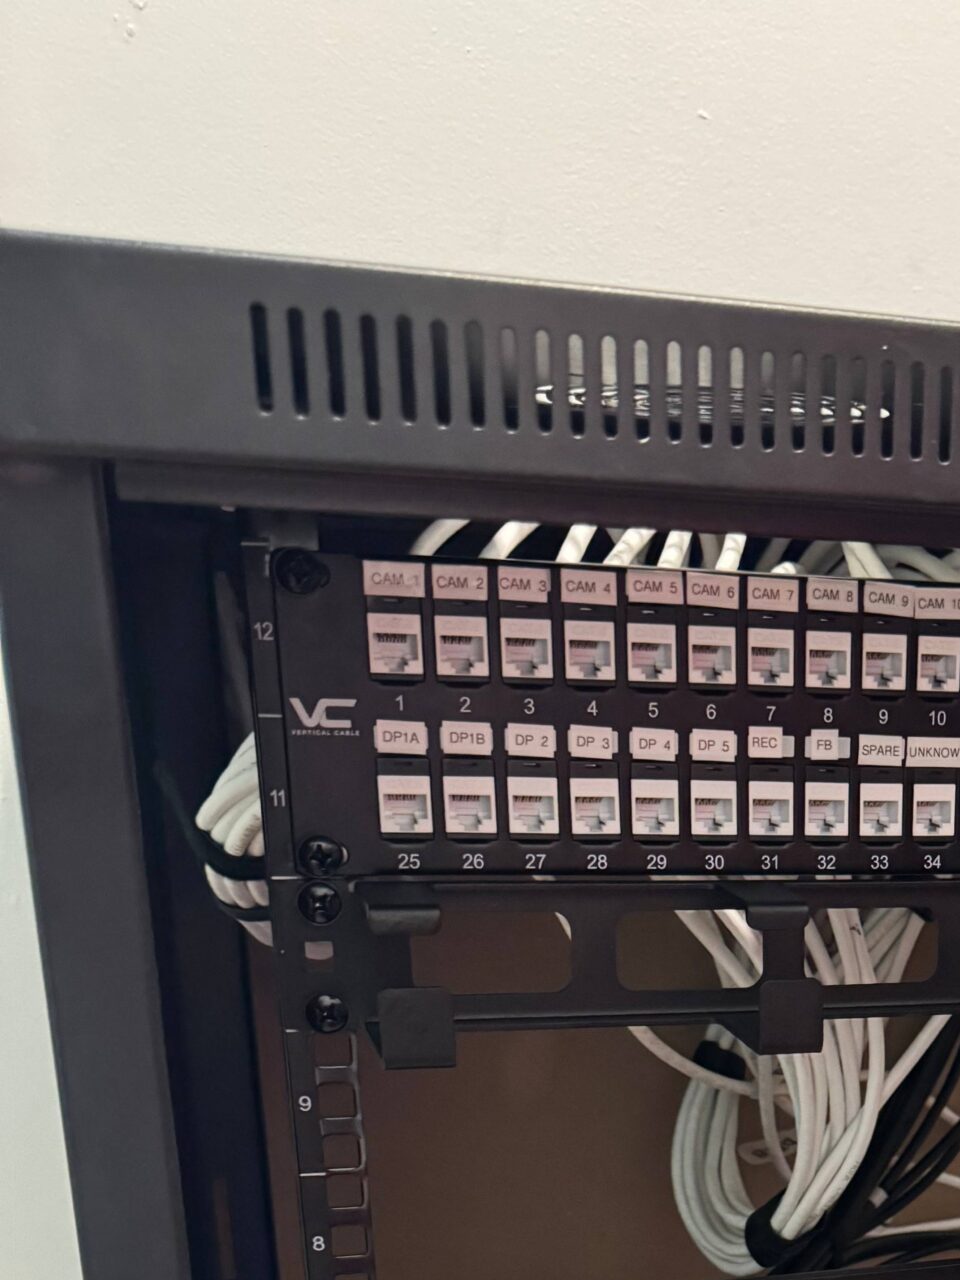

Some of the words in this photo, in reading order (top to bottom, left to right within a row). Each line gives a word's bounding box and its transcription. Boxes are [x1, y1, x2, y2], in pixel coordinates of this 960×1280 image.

[436, 576, 470, 589] CAM
[476, 577, 484, 590] 2
[500, 577, 532, 590] CAM
[538, 580, 547, 592] 3
[565, 580, 596, 593] CAM
[603, 583, 611, 594] 4
[633, 580, 663, 593] CAM
[670, 581, 677, 594] 5
[692, 583, 720, 597] CAM
[727, 586, 735, 599] 6
[752, 587, 780, 600] CAM
[787, 590, 794, 601] 7
[813, 587, 840, 600] CAM
[847, 591, 854, 602] 8
[869, 591, 896, 605] CAM
[901, 594, 909, 607] 9
[918, 596, 945, 609] CAM
[254, 622, 274, 641] 12
[396, 695, 405, 712] 1
[460, 697, 472, 713] 2
[523, 698, 535, 714] 3
[587, 700, 599, 716] 4
[648, 703, 659, 718] 5
[706, 703, 717, 719] 6
[289, 697, 357, 728] VC
[766, 706, 777, 721] 7
[823, 708, 834, 723] 8
[879, 709, 889, 725] 9
[928, 710, 947, 726] 10
[382, 730, 419, 744] DP1A
[449, 731, 486, 745] DP1B
[515, 733, 535, 747] DP
[540, 735, 549, 748] 2
[639, 738, 657, 750] DP
[664, 740, 671, 751] 4
[752, 737, 777, 749] REC
[698, 740, 716, 751] DP
[722, 741, 729, 752] 5
[817, 740, 832, 751] FB
[861, 744, 900, 756] SPARE
[270, 790, 286, 807] 11
[398, 854, 421, 870] 25
[462, 854, 484, 870] 26
[525, 854, 547, 869] 27
[586, 854, 608, 869] 28
[646, 855, 668, 870] 29
[705, 855, 725, 870] 30
[761, 855, 779, 870] 31
[817, 855, 836, 870] 32
[870, 855, 889, 870] 33
[924, 855, 941, 869] 34
[299, 1095, 312, 1112] 9
[312, 1236, 325, 1252] 8
